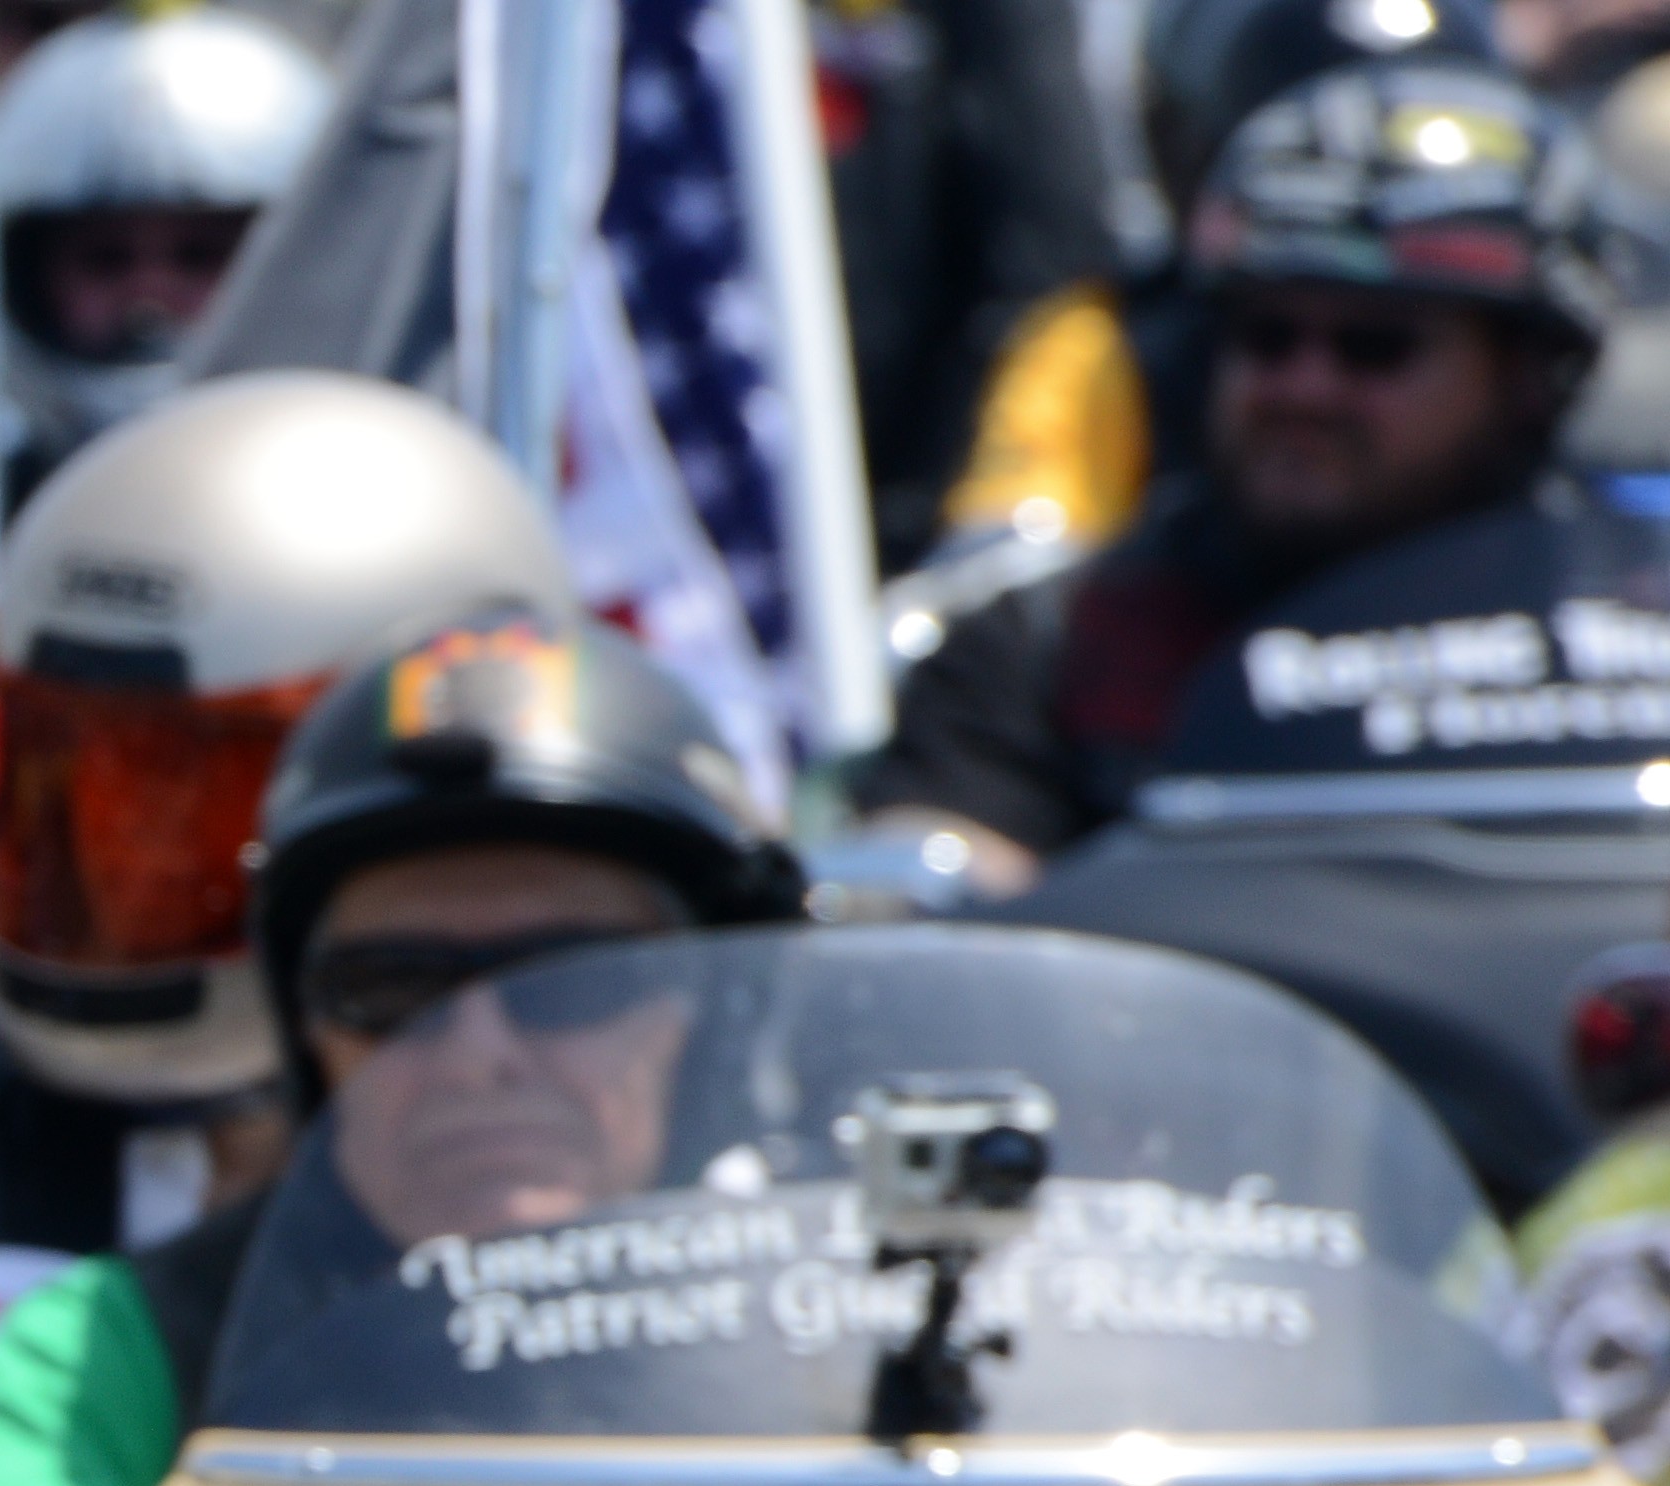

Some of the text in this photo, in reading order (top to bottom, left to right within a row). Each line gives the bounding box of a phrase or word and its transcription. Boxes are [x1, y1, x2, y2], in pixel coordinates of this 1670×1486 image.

[1102, 1174, 1366, 1266] Riders
[772, 1253, 1030, 1358] Guad
[1054, 1260, 1318, 1342] Riders
